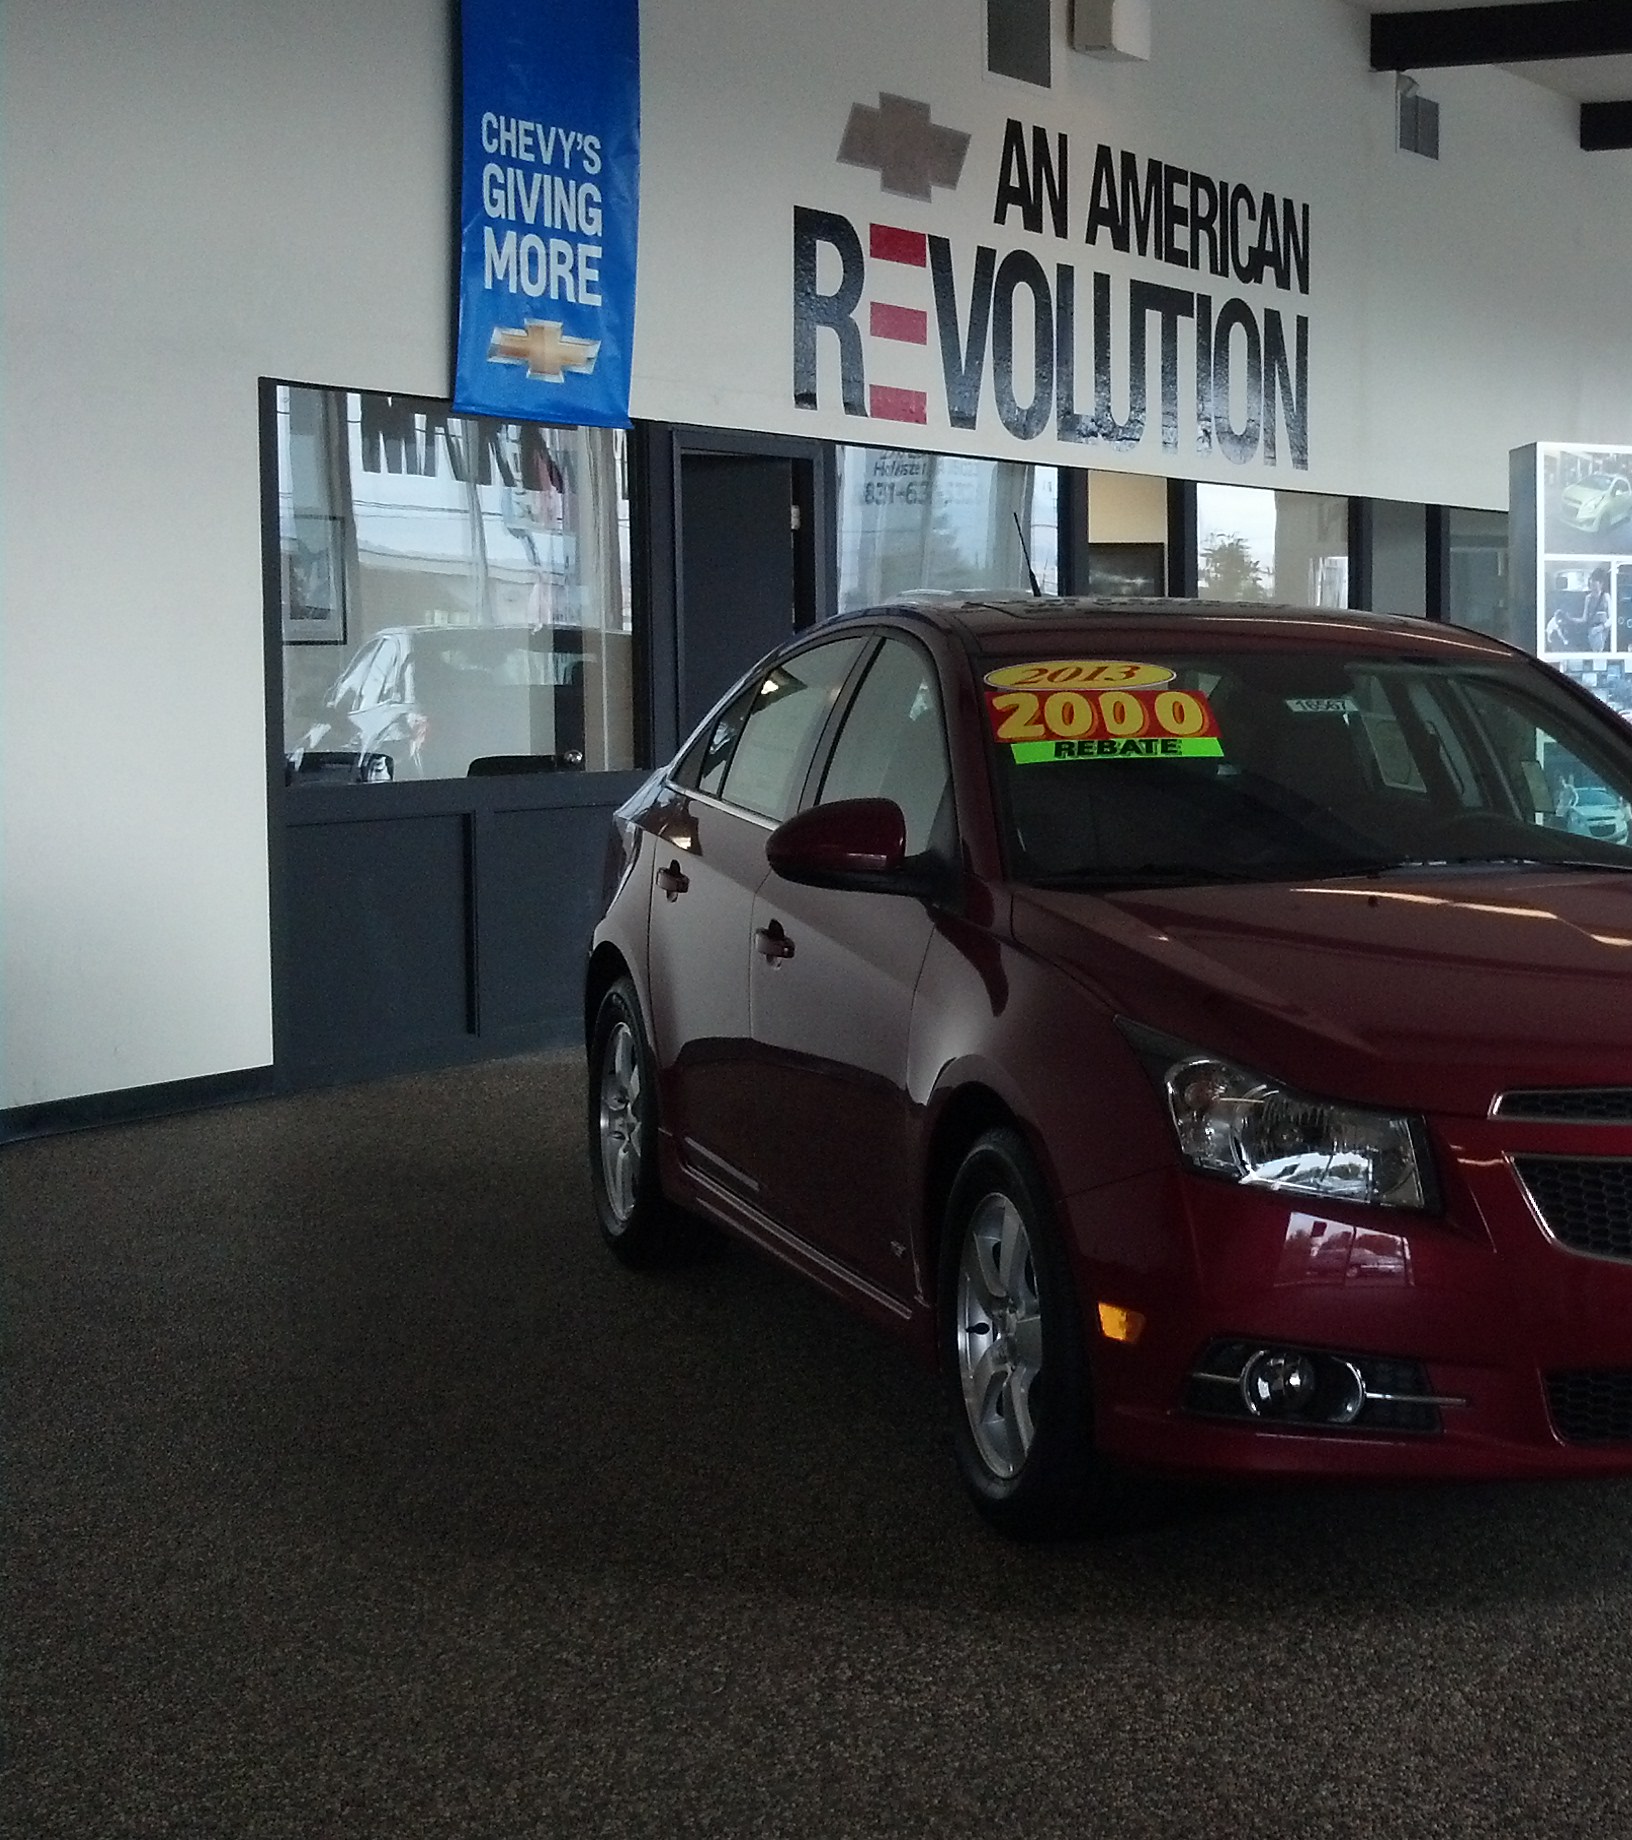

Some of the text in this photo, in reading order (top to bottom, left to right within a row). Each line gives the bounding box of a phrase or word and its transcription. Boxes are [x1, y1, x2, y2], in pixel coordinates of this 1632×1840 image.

[481, 112, 601, 174] CHEVY'S
[482, 164, 602, 235] GIVING
[994, 118, 1309, 294] AN AMERICAN
[483, 227, 602, 305] MORE
[794, 205, 1309, 471] REVOLUTION
[1014, 665, 1141, 686] 2013
[992, 692, 1207, 738] 2000
[1054, 738, 1180, 758] REBATE
